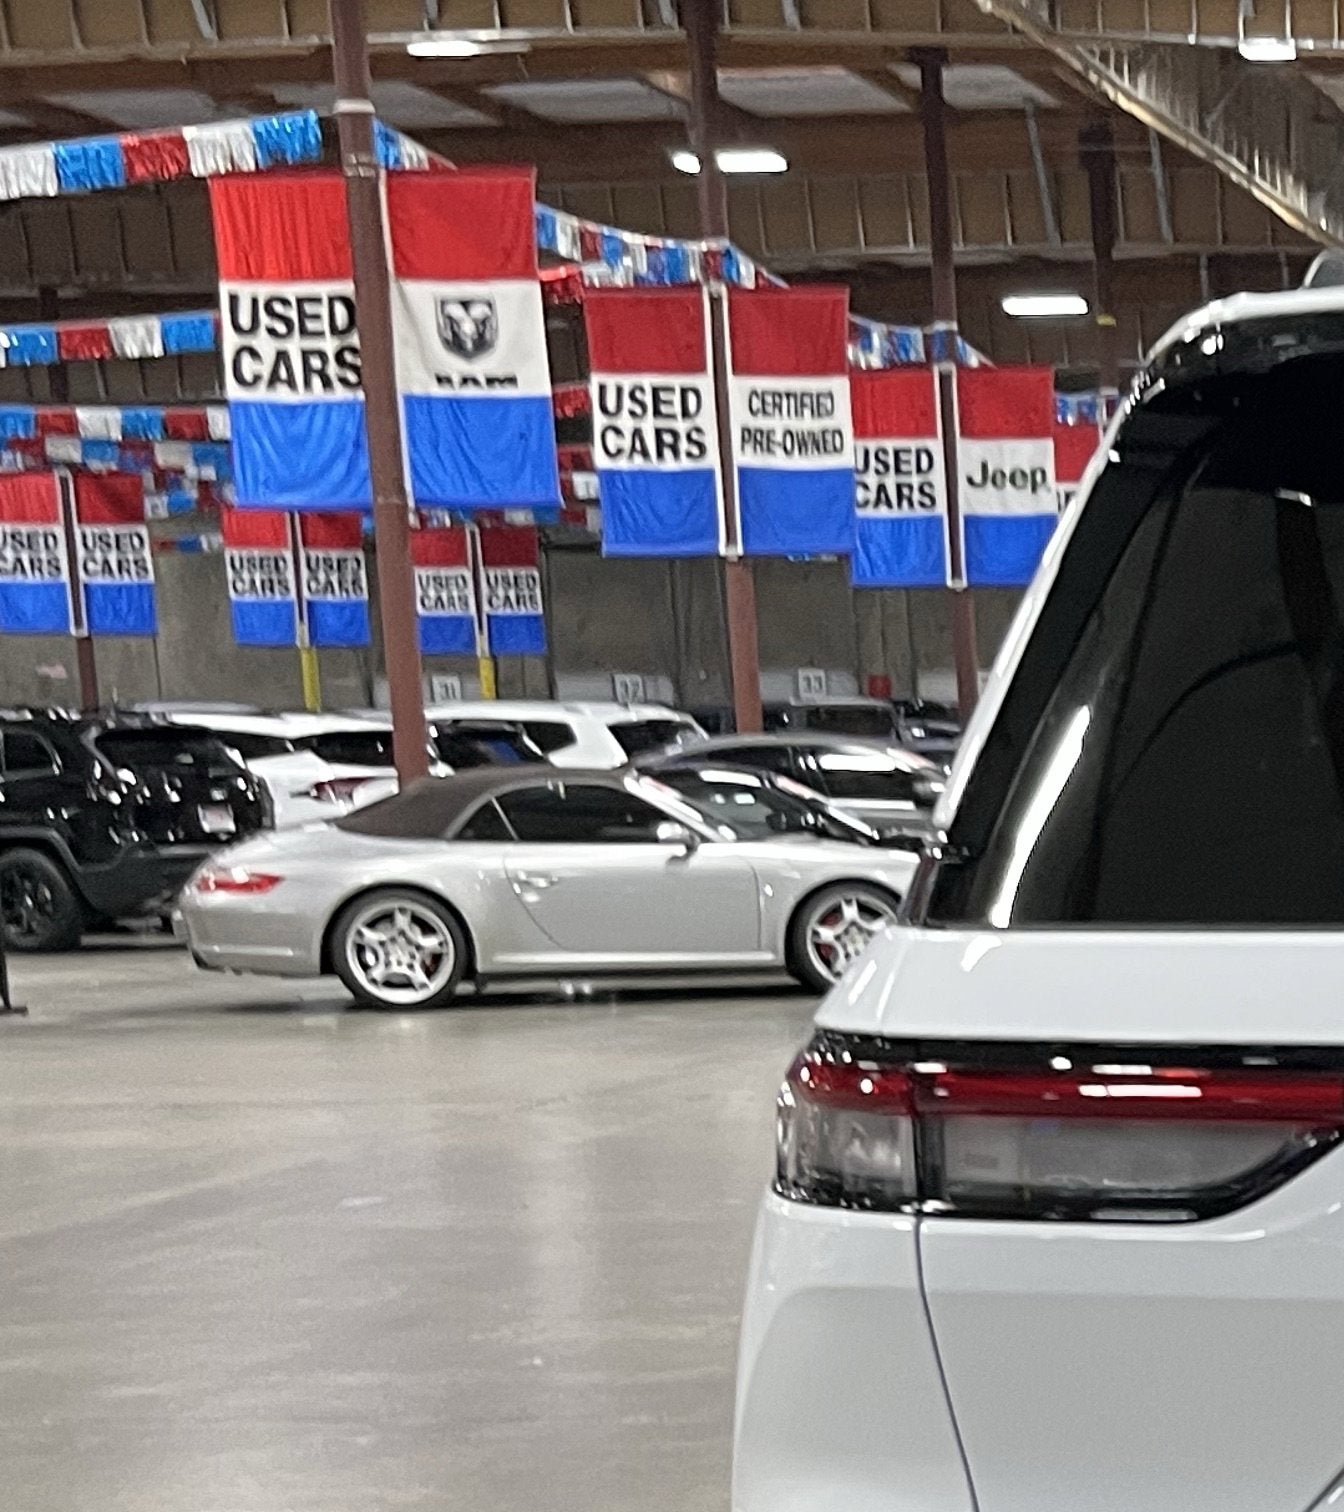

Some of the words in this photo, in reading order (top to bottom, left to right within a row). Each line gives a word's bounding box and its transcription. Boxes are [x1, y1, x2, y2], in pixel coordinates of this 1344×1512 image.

[228, 292, 356, 340] USED
[231, 346, 362, 394] CARS
[598, 383, 701, 421] USED
[748, 389, 835, 418] CERTIFIED
[600, 424, 707, 462] CARS
[740, 426, 845, 457] PRE-OWNED
[854, 446, 934, 477] USED
[966, 460, 1048, 493] Jeep
[855, 480, 936, 511] CARS
[82, 530, 145, 553] USED
[82, 555, 150, 579] CARS
[418, 573, 468, 590] USED
[486, 572, 538, 591] USED
